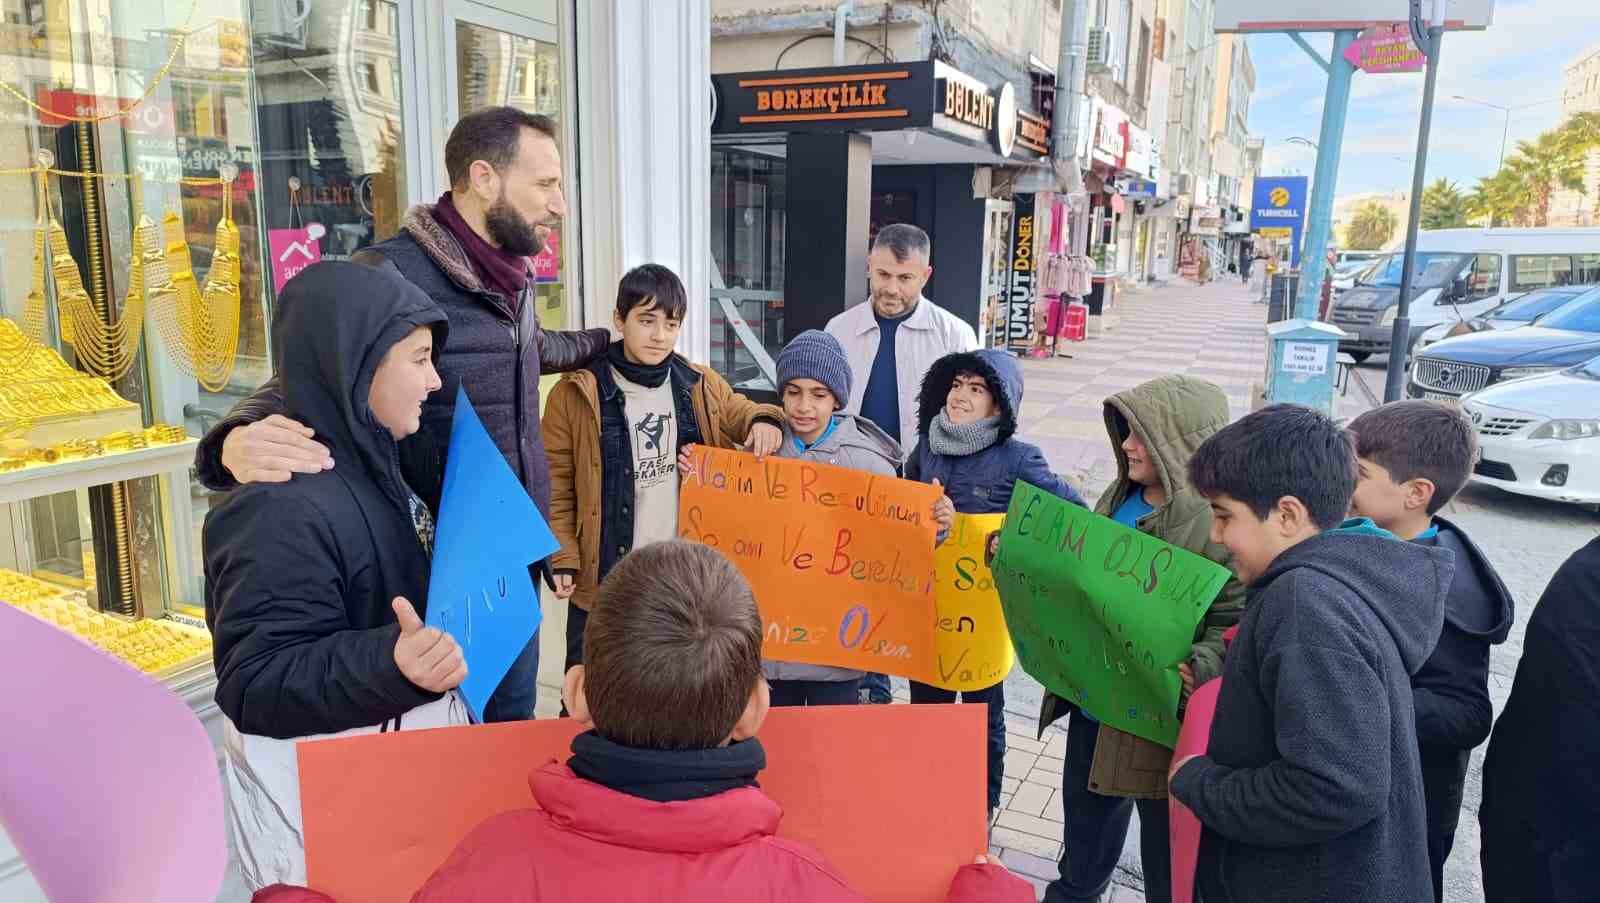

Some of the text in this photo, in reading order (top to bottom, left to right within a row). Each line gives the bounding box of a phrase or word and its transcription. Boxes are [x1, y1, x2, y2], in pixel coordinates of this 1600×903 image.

[1010, 271, 1030, 338] UMUT
[632, 463, 675, 480] SKATER
[640, 456, 667, 471] FAST
[765, 460, 787, 500] Ve
[782, 523, 813, 570] Ve
